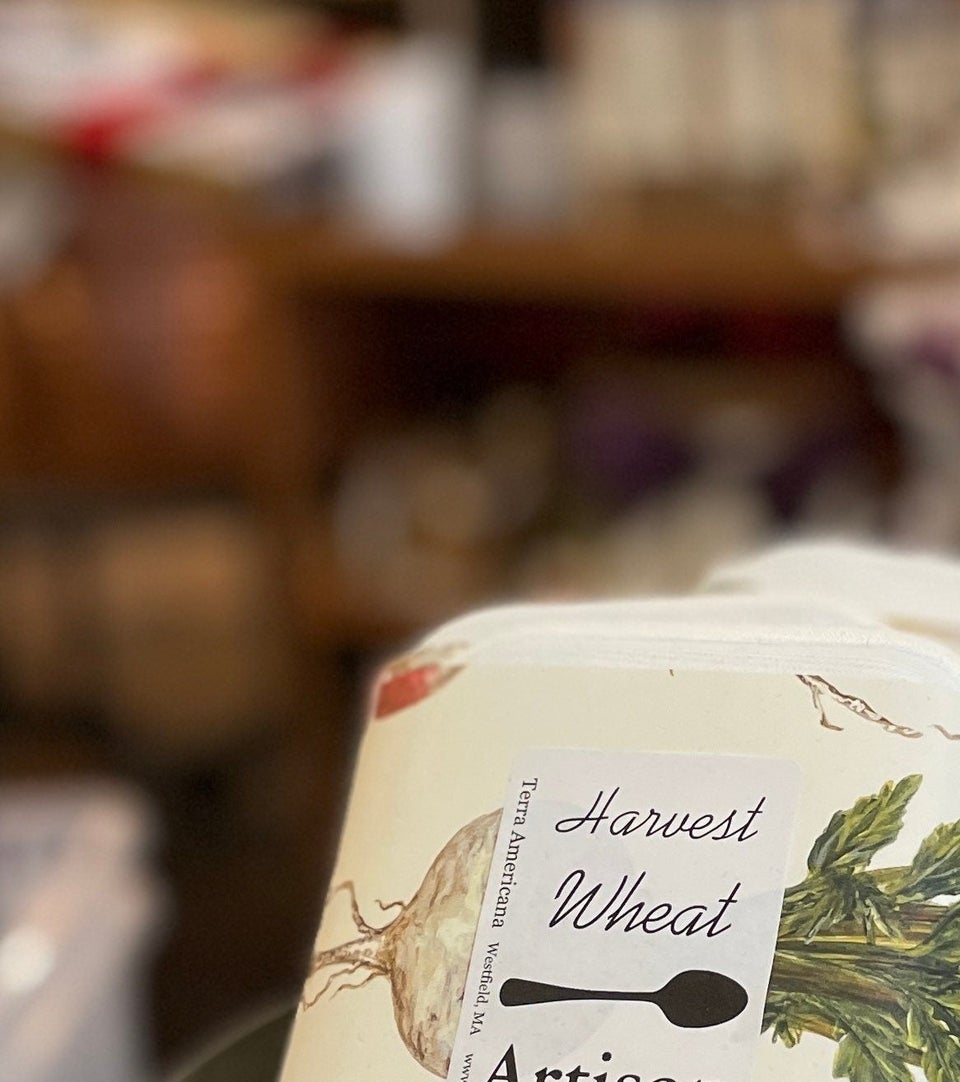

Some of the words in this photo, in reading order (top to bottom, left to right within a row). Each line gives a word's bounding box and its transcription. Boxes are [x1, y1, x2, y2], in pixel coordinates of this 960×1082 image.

[513, 777, 538, 826] Terra
[555, 786, 766, 842] Harvest
[491, 829, 527, 929] Americana
[549, 869, 742, 938] Wheat
[472, 942, 500, 1007] Westfield,
[469, 1011, 487, 1036] MA
